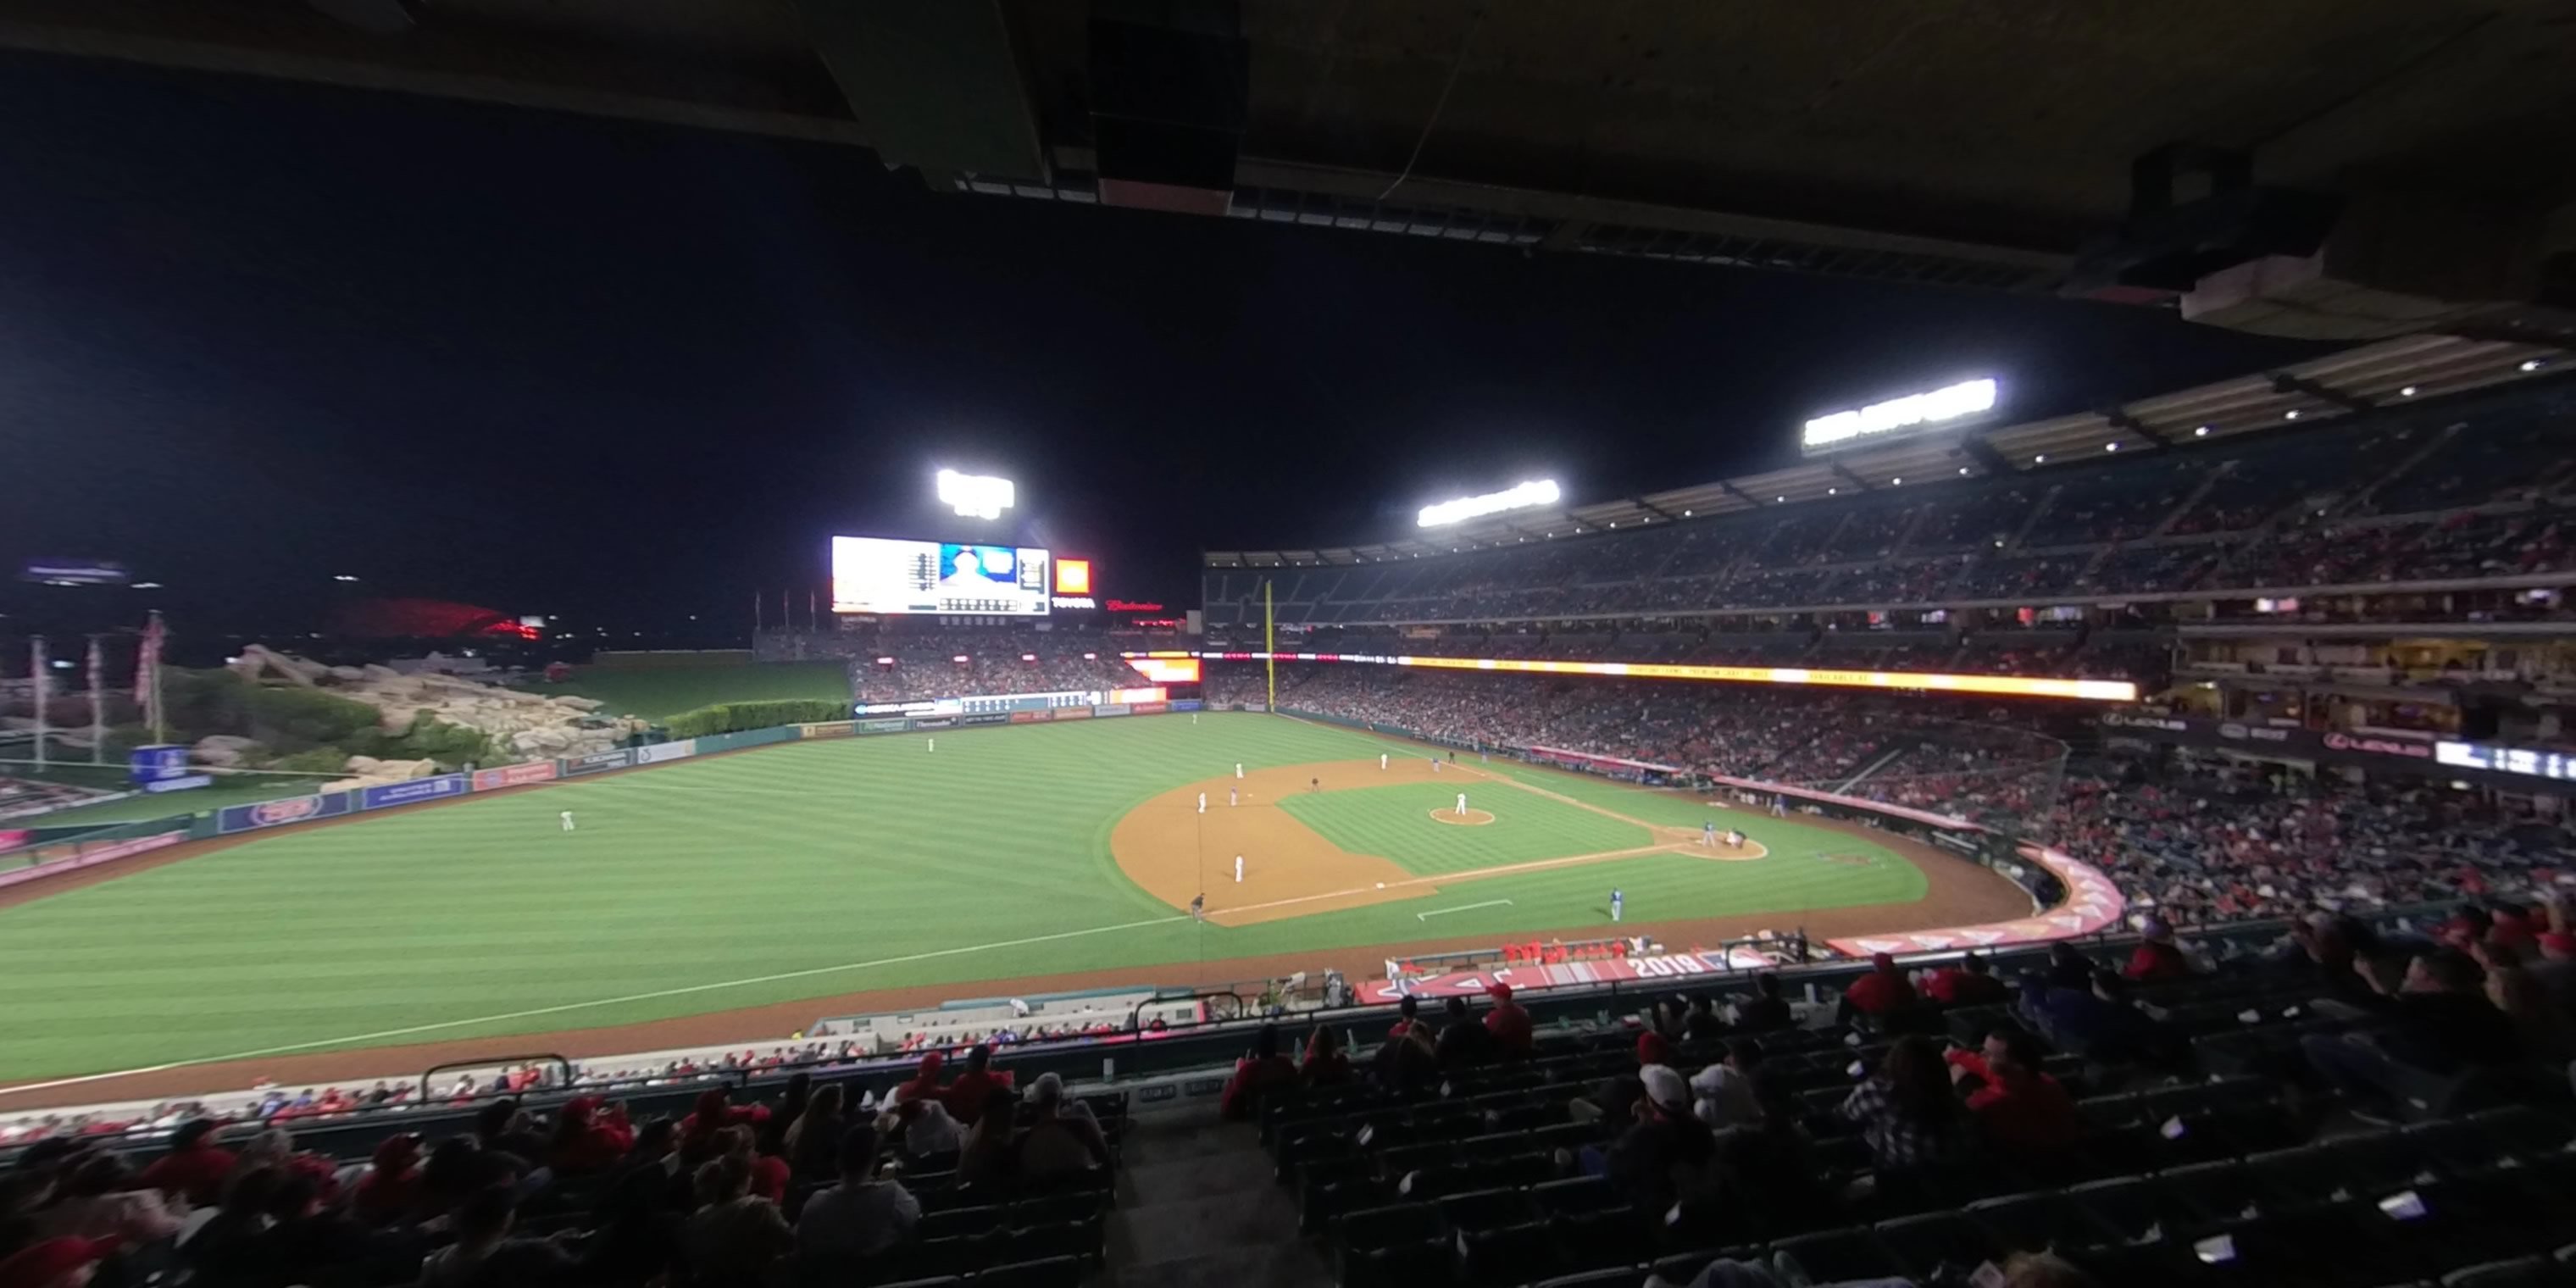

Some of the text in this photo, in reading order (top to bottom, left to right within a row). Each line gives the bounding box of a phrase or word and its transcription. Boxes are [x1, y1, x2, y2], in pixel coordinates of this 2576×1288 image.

[1052, 597, 1095, 608] TOYOTA
[2124, 717, 2186, 730] LEXUS
[2351, 740, 2429, 757] LEXUS
[1627, 954, 1704, 978] 2019
